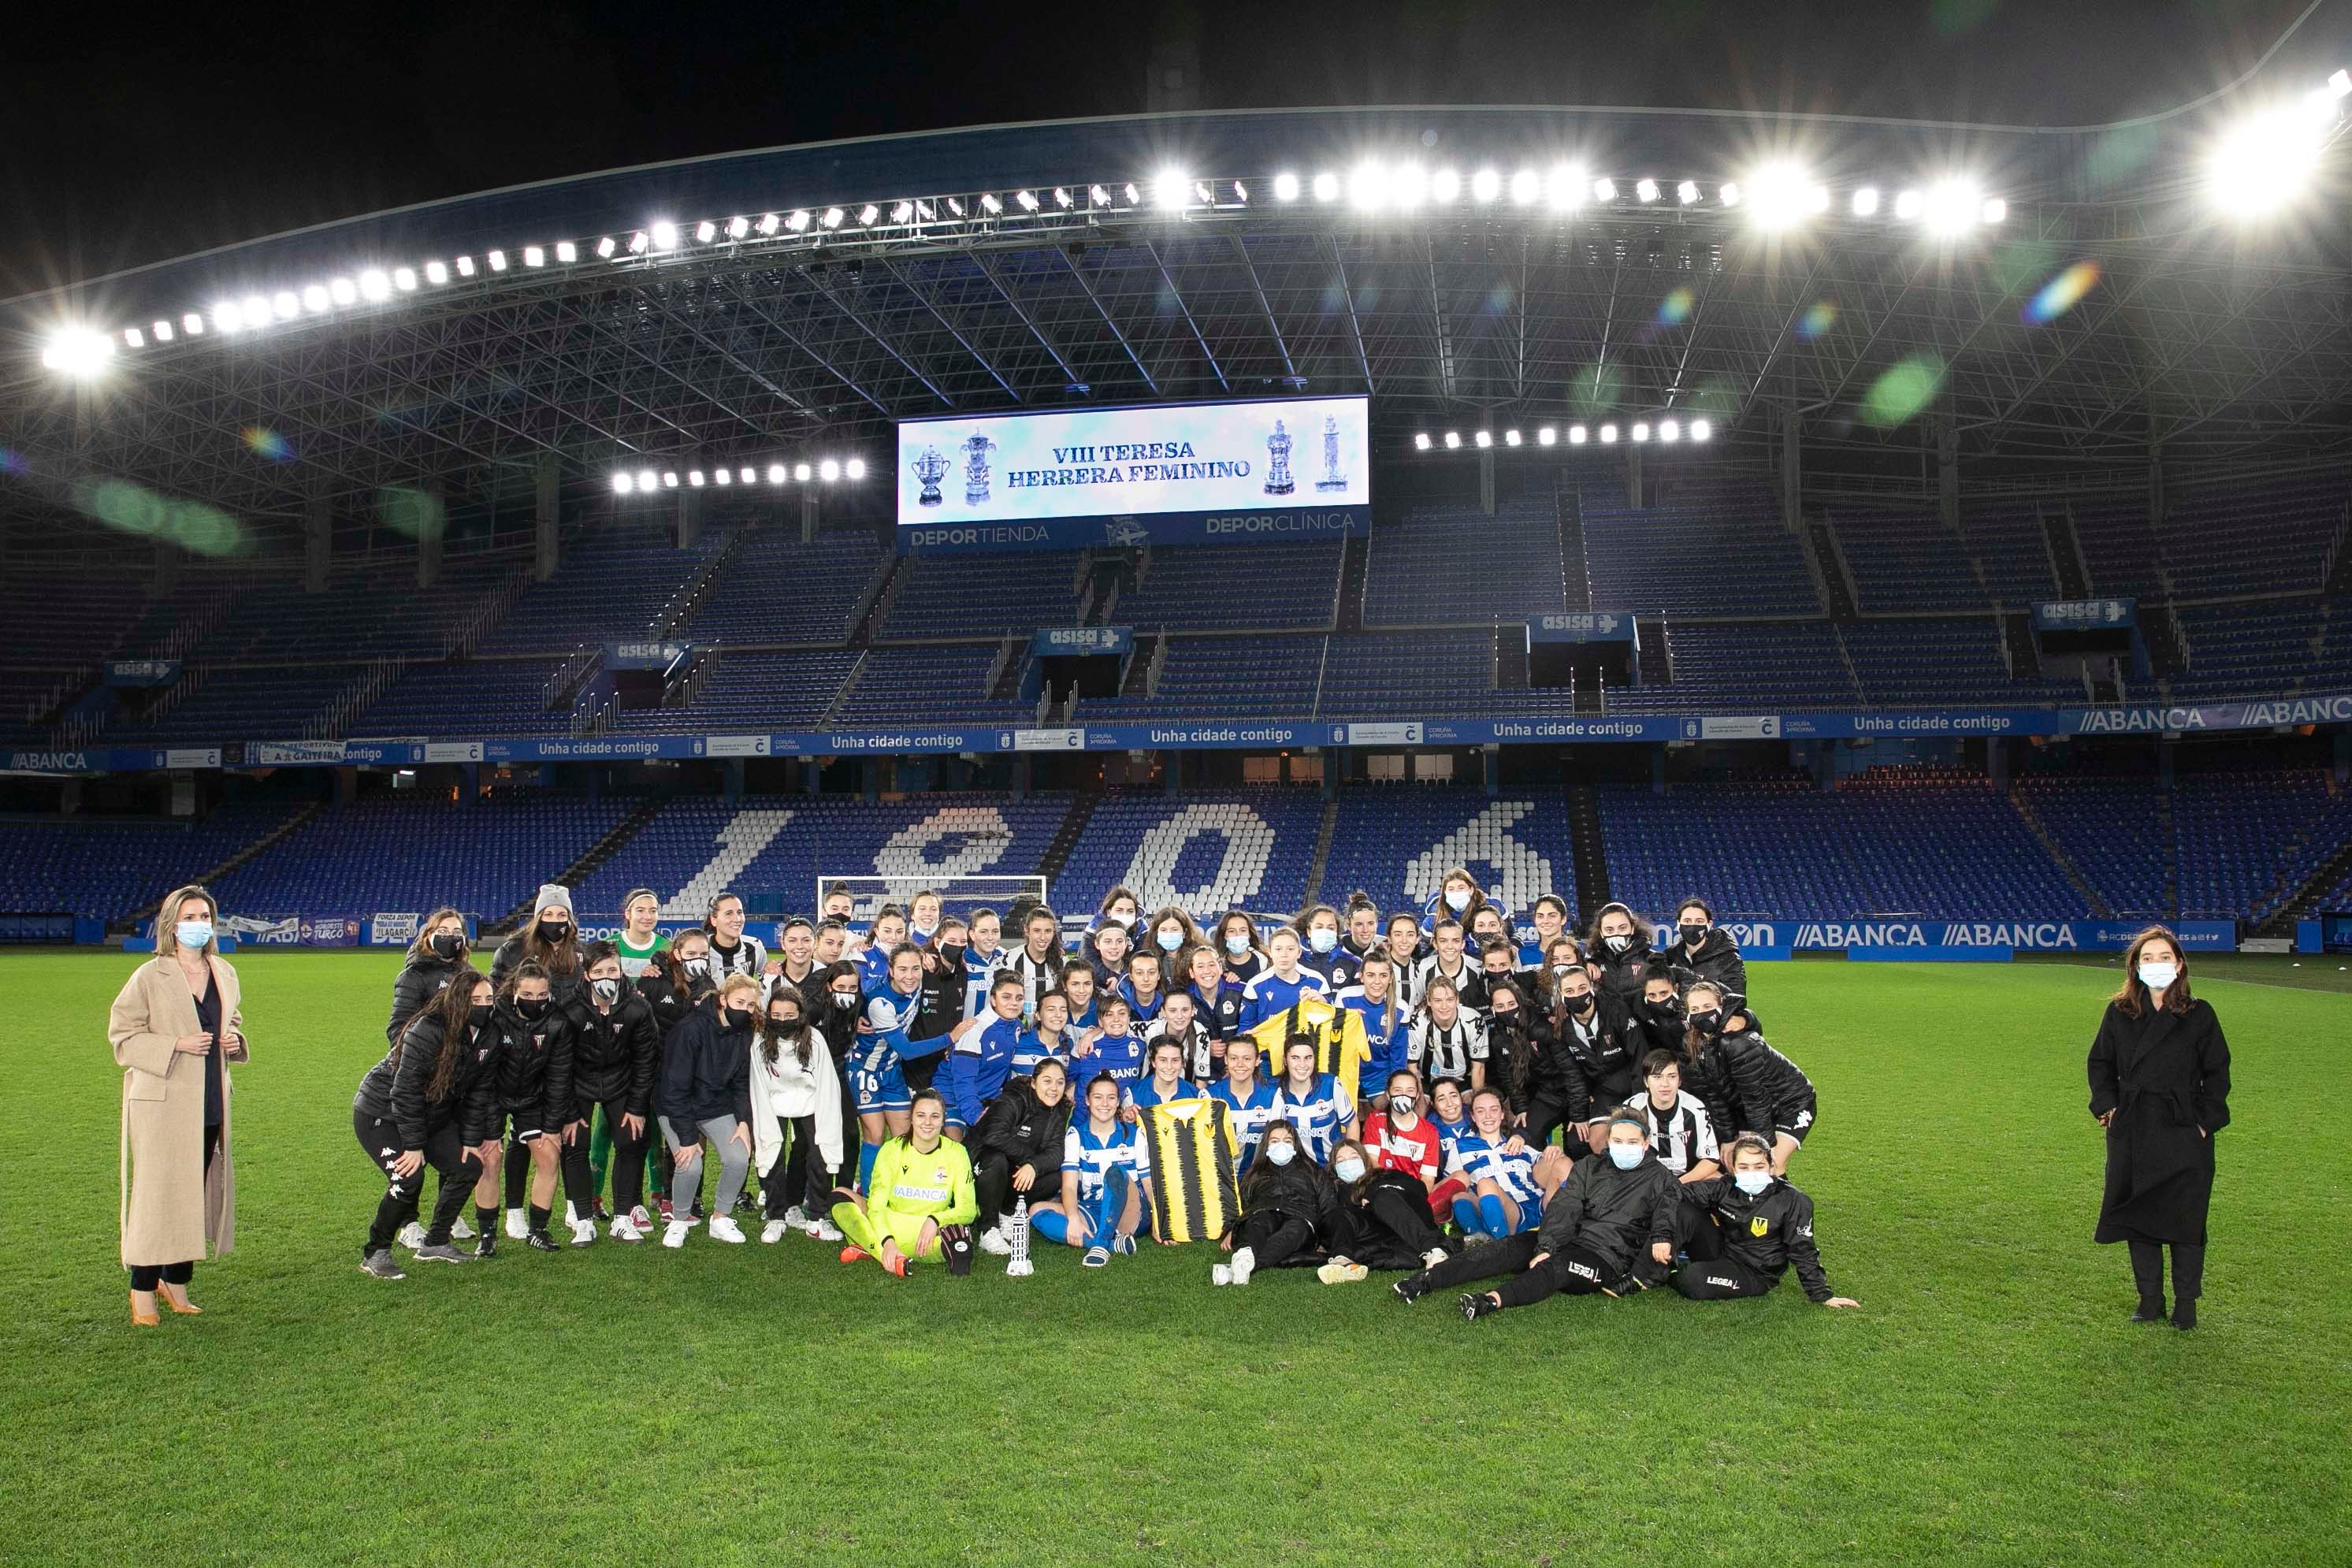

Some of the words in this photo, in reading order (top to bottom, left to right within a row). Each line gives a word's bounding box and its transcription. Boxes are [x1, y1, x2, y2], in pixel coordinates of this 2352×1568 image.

[1053, 447, 1095, 464] VIII
[1100, 442, 1195, 462] TERESA
[1009, 466, 1124, 488] HERRERA
[1128, 460, 1250, 482] FEMININO
[2042, 602, 2100, 617] asisa
[1542, 615, 1594, 630] asisa
[1050, 630, 1097, 644] asisa
[617, 644, 660, 657] asisa
[1493, 723, 1531, 736] Unha
[1536, 722, 1584, 735] cidade
[1588, 722, 1643, 737] contigo
[1854, 716, 1893, 730] Unha
[1898, 716, 1949, 729] cidade
[1953, 715, 2010, 731] contigo
[831, 736, 865, 749] Unha
[868, 735, 911, 748] cidade
[915, 734, 963, 749] contigo
[1151, 730, 1187, 742] Unha
[1191, 729, 1236, 741] cidade
[1240, 728, 1292, 743] contigo
[539, 743, 569, 754] Unha
[573, 741, 611, 754] cidade
[615, 741, 659, 755] contigo
[314, 929, 344, 940] TURCO
[856, 1070, 879, 1091] 16
[1707, 1276, 1733, 1287] LEGEA
